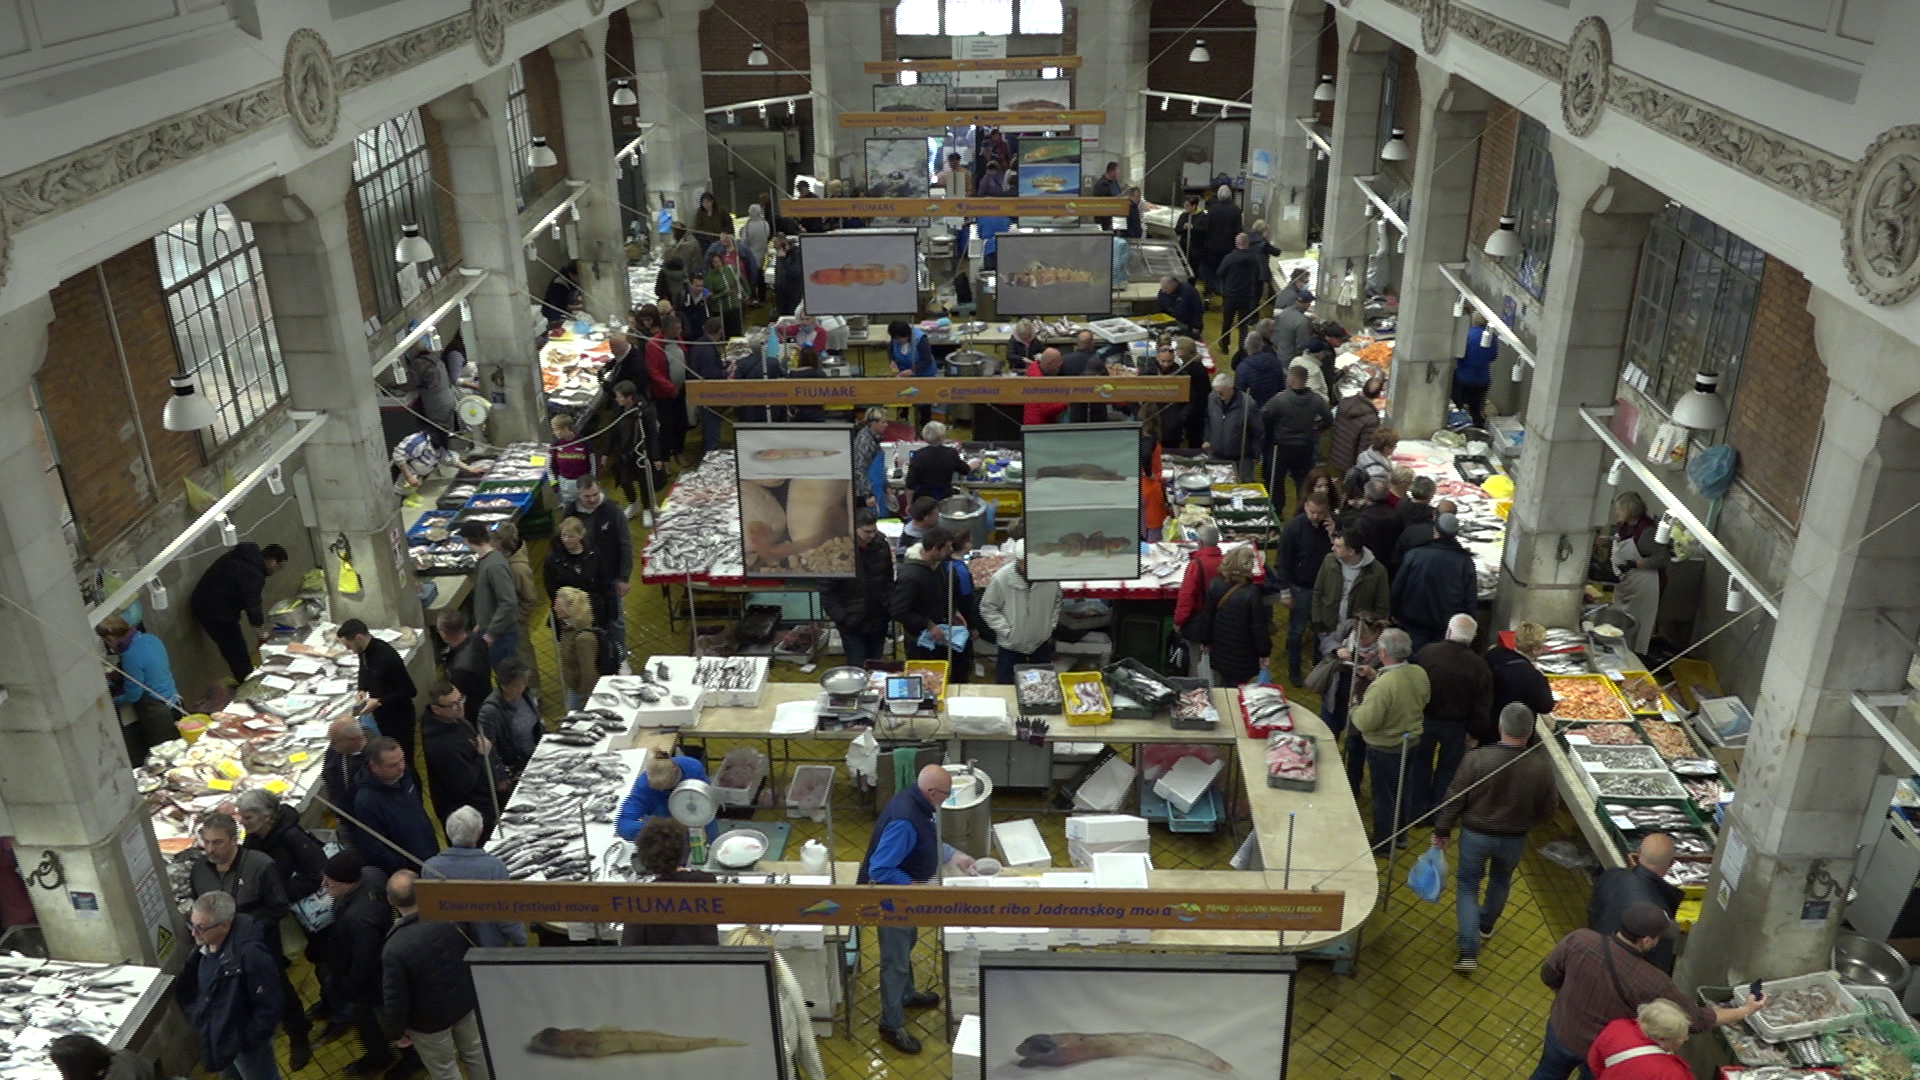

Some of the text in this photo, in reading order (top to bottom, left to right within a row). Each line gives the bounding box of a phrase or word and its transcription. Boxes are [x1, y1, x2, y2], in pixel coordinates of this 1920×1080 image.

[795, 386, 857, 398] FIUMARE
[439, 900, 599, 913] Kvarnerski festival mora
[612, 896, 725, 914] FIUMARE
[1000, 903, 1031, 915] riba
[1035, 903, 1126, 919] Jadranskog
